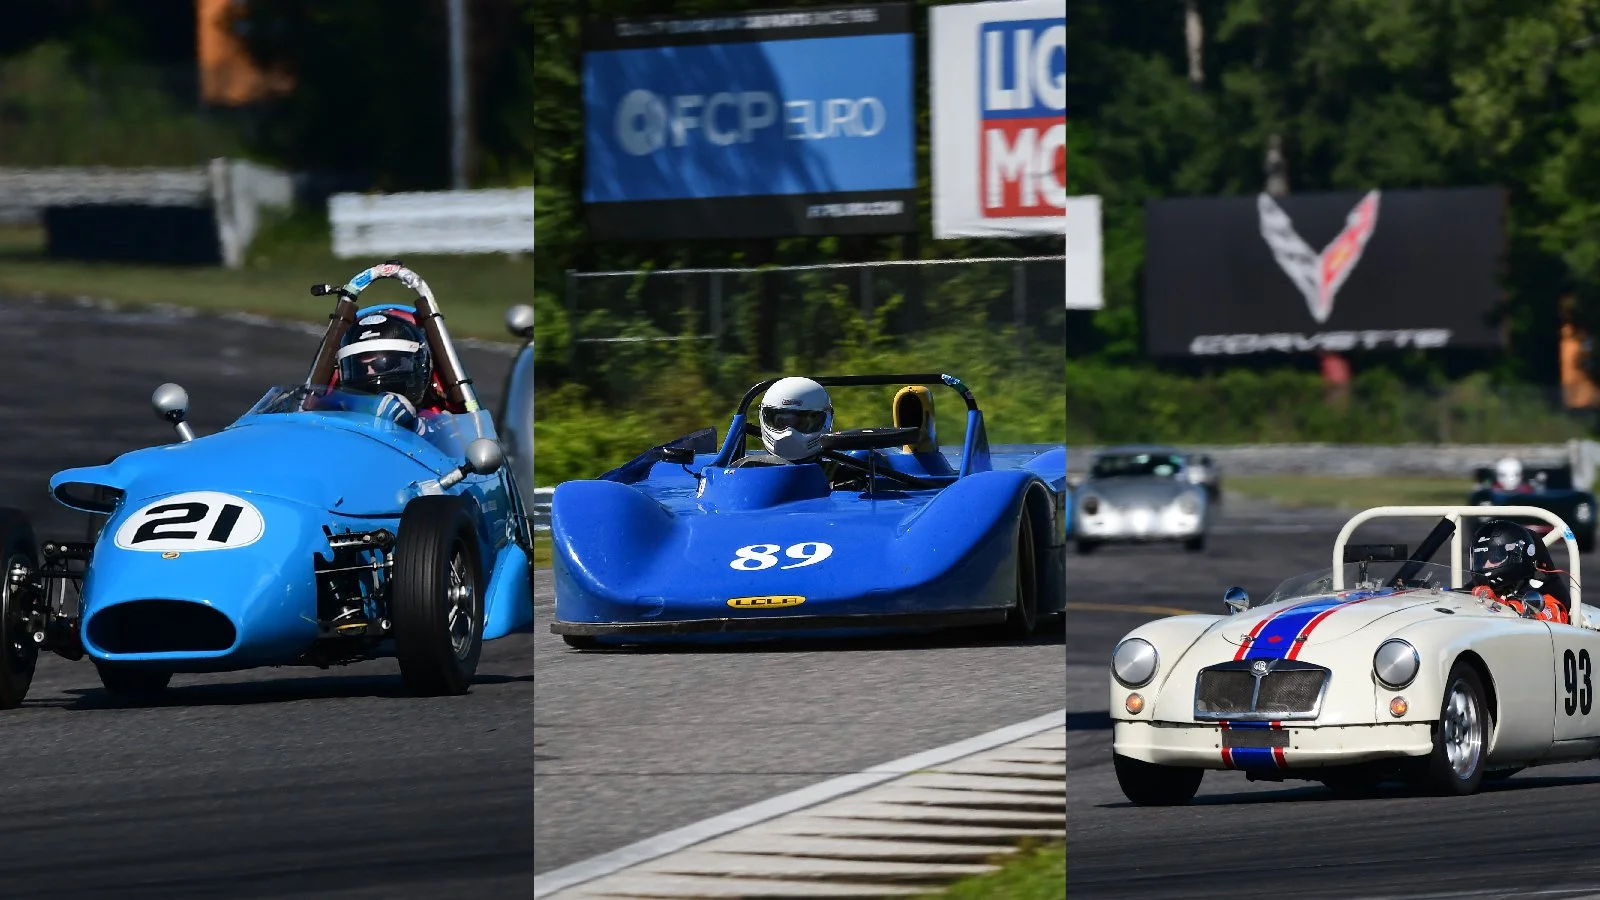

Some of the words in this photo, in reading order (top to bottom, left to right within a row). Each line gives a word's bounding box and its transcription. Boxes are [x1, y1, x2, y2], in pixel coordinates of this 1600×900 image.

[670, 90, 778, 147] FCP
[783, 97, 886, 141] EURO
[1189, 328, 1452, 355] CORVETTE
[131, 502, 243, 544] 21
[729, 542, 834, 571] 89
[735, 597, 797, 606] LOLA
[1563, 648, 1593, 716] 93
